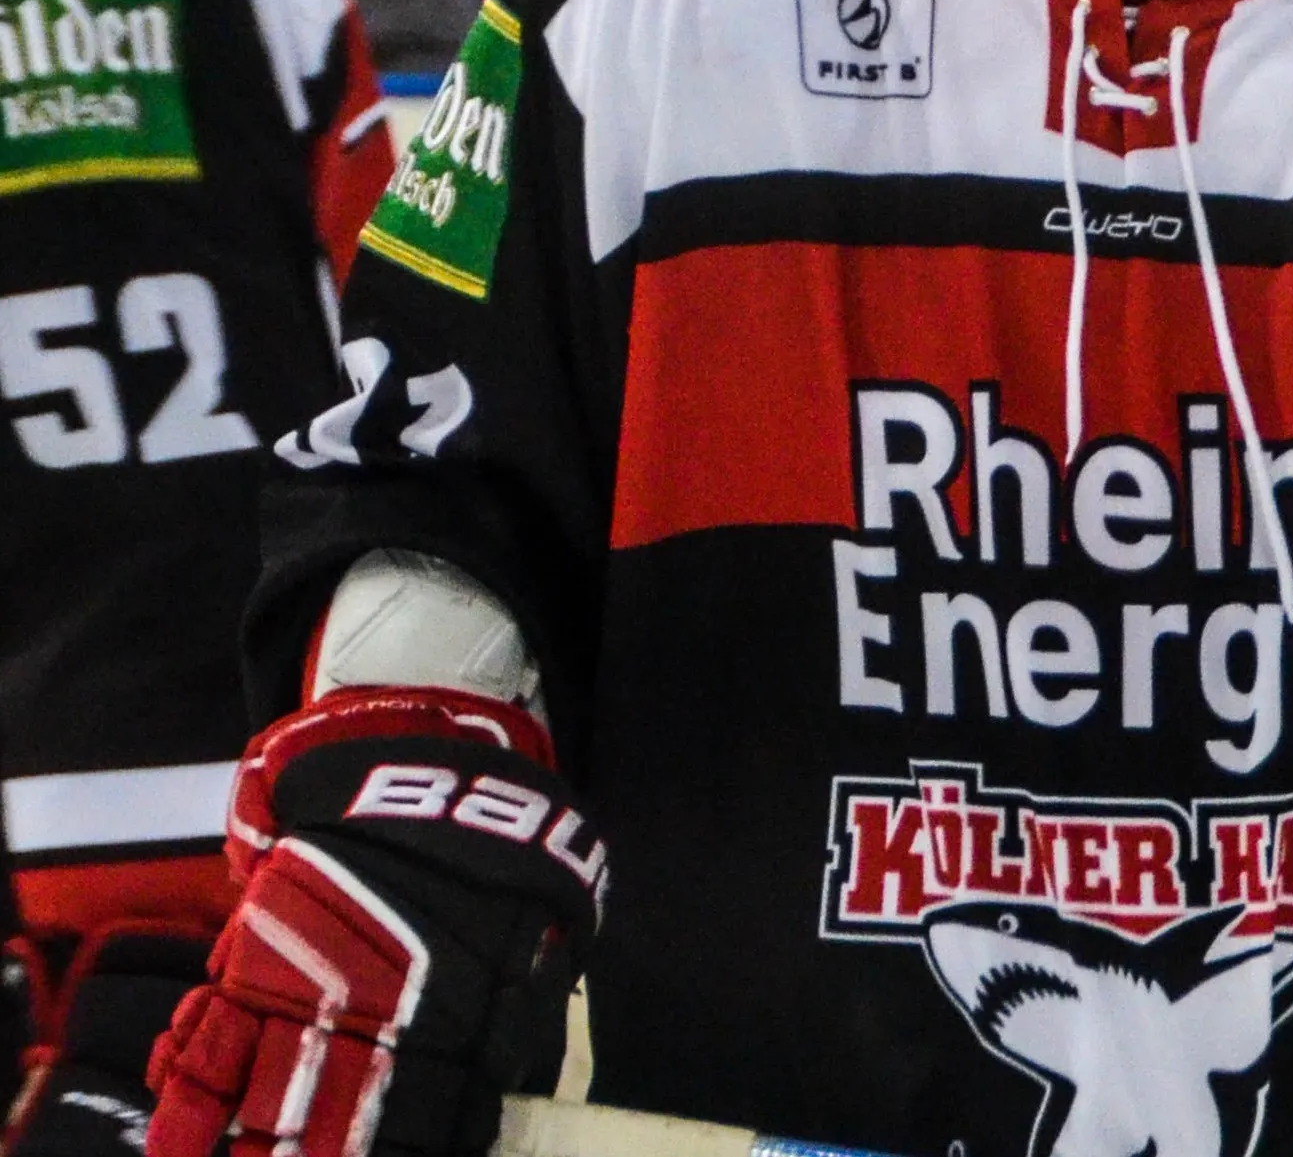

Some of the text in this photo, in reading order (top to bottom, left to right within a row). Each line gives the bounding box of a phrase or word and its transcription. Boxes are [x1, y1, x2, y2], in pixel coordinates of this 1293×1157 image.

[819, 60, 888, 82] FIRST
[0, 272, 260, 469] 52
[344, 763, 609, 902] BAU
[838, 779, 1188, 920] KÖLNER
